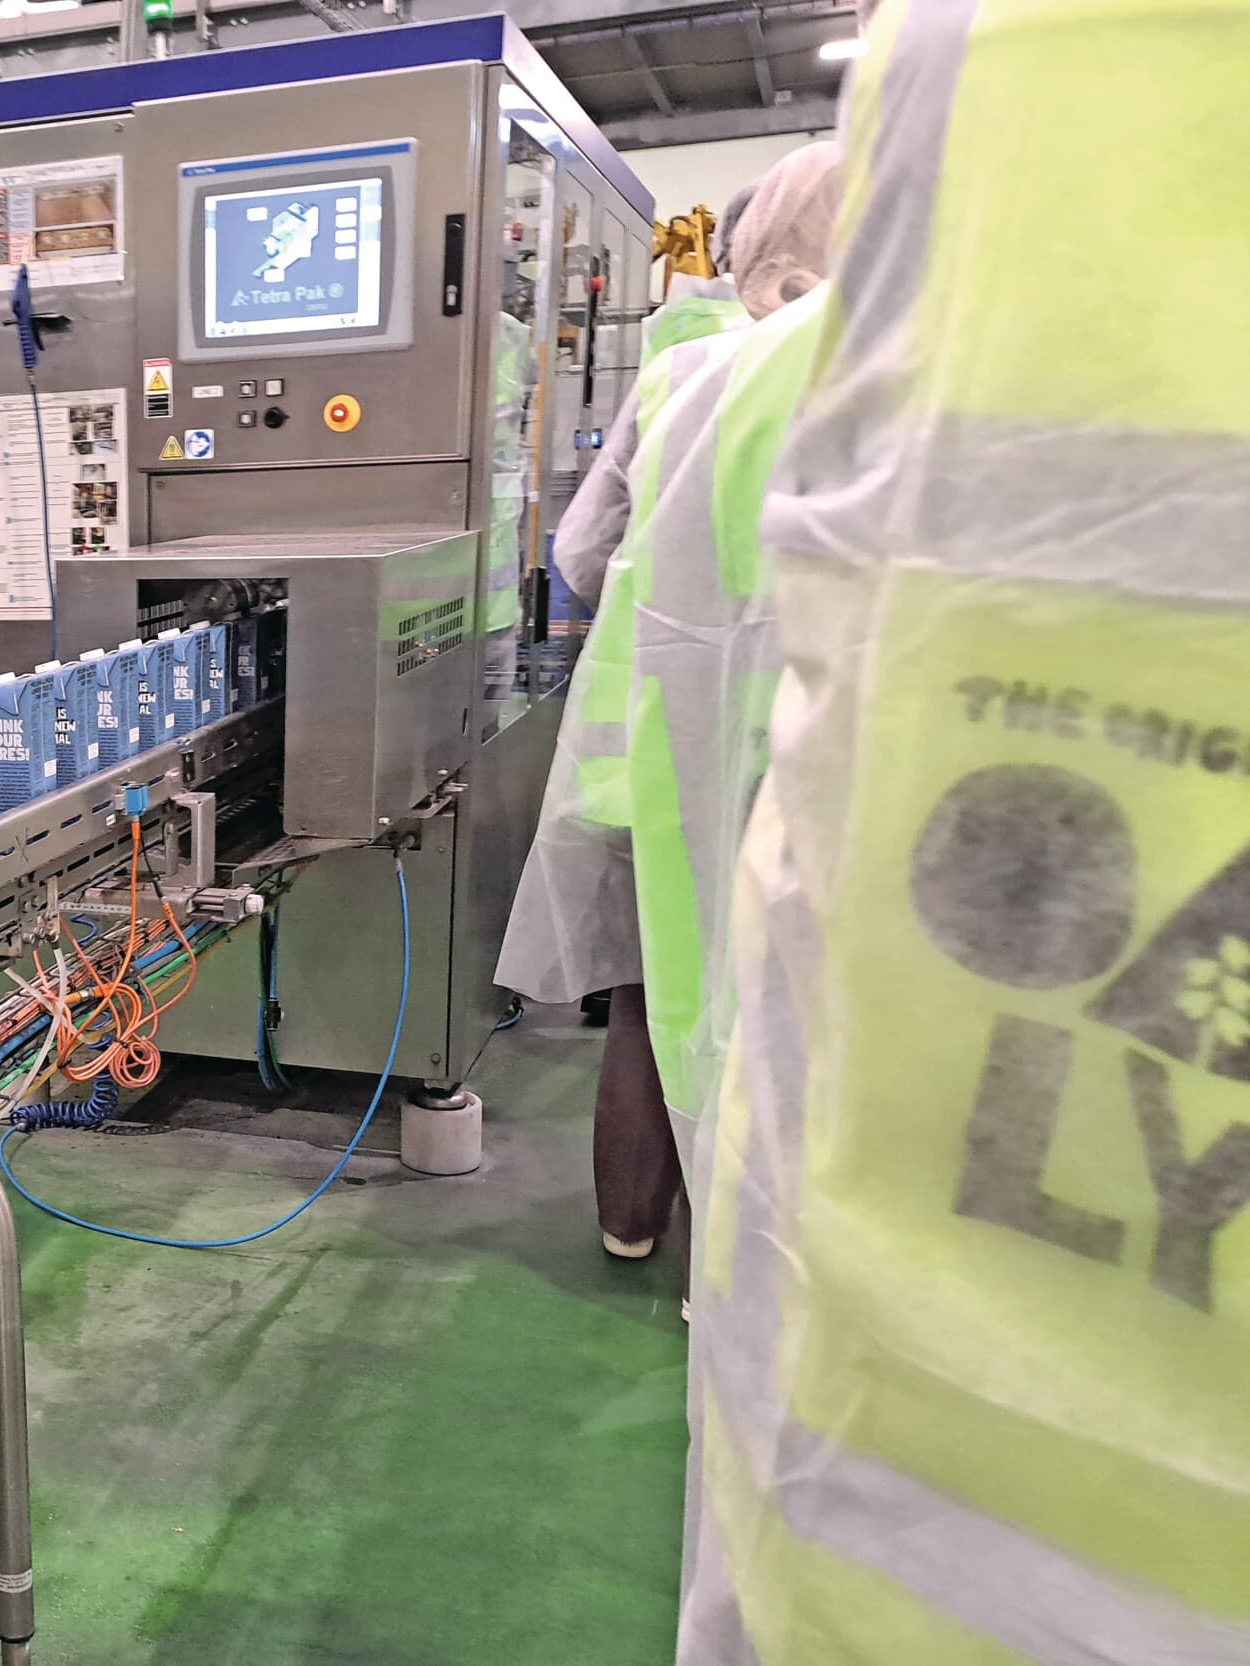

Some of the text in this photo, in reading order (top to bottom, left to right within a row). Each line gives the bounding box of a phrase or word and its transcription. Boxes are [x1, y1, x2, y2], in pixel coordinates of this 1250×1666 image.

[251, 290, 291, 304] Tetra
[294, 286, 325, 301] Pak
[139, 682, 148, 692] IS
[58, 708, 67, 719] IS
[54, 721, 76, 732] NEW
[952, 675, 1250, 771] THE ORIG
